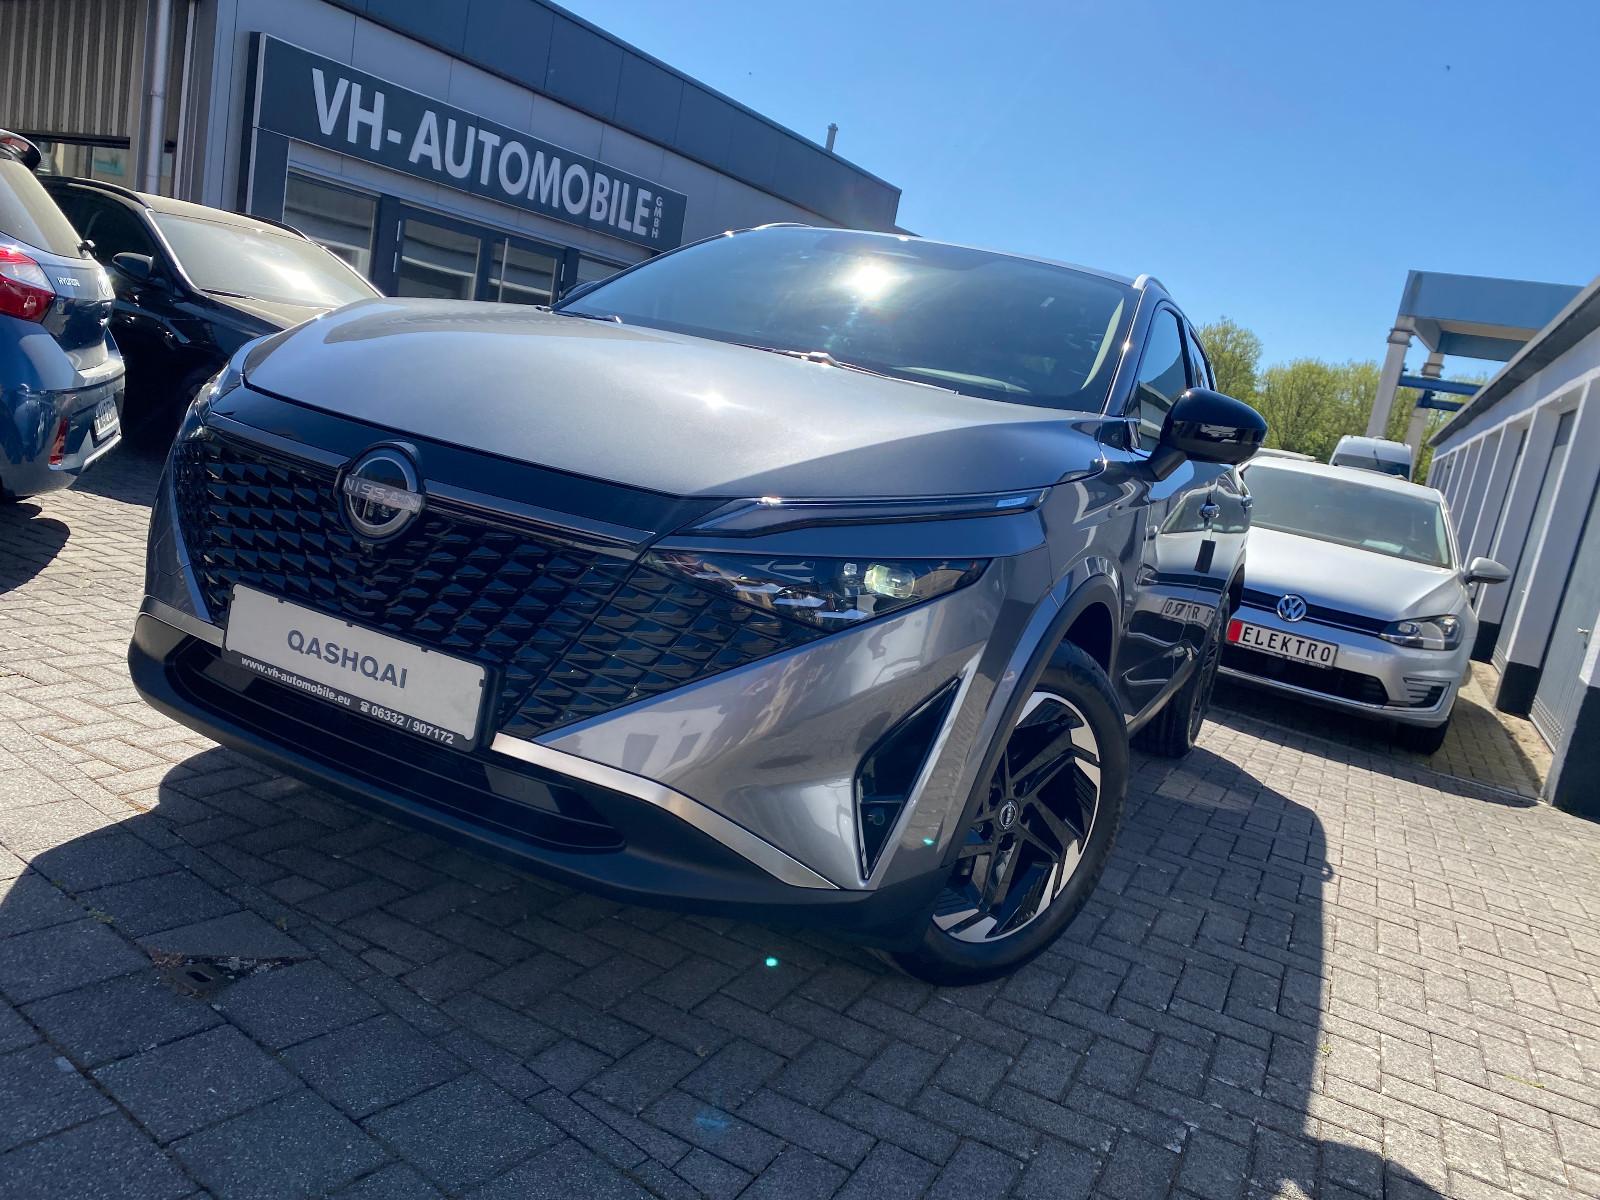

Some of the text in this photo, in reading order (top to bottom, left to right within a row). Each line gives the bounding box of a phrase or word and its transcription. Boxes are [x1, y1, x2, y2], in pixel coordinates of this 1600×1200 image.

[651, 196, 663, 239] GMBH
[343, 478, 421, 508] NISSAN
[287, 629, 408, 689] QASHQAI
[1242, 626, 1331, 662] ELEKTRO
[241, 656, 351, 706] www.vh-automobile.eu
[371, 701, 404, 726] 06332
[412, 720, 455, 745] 907172
